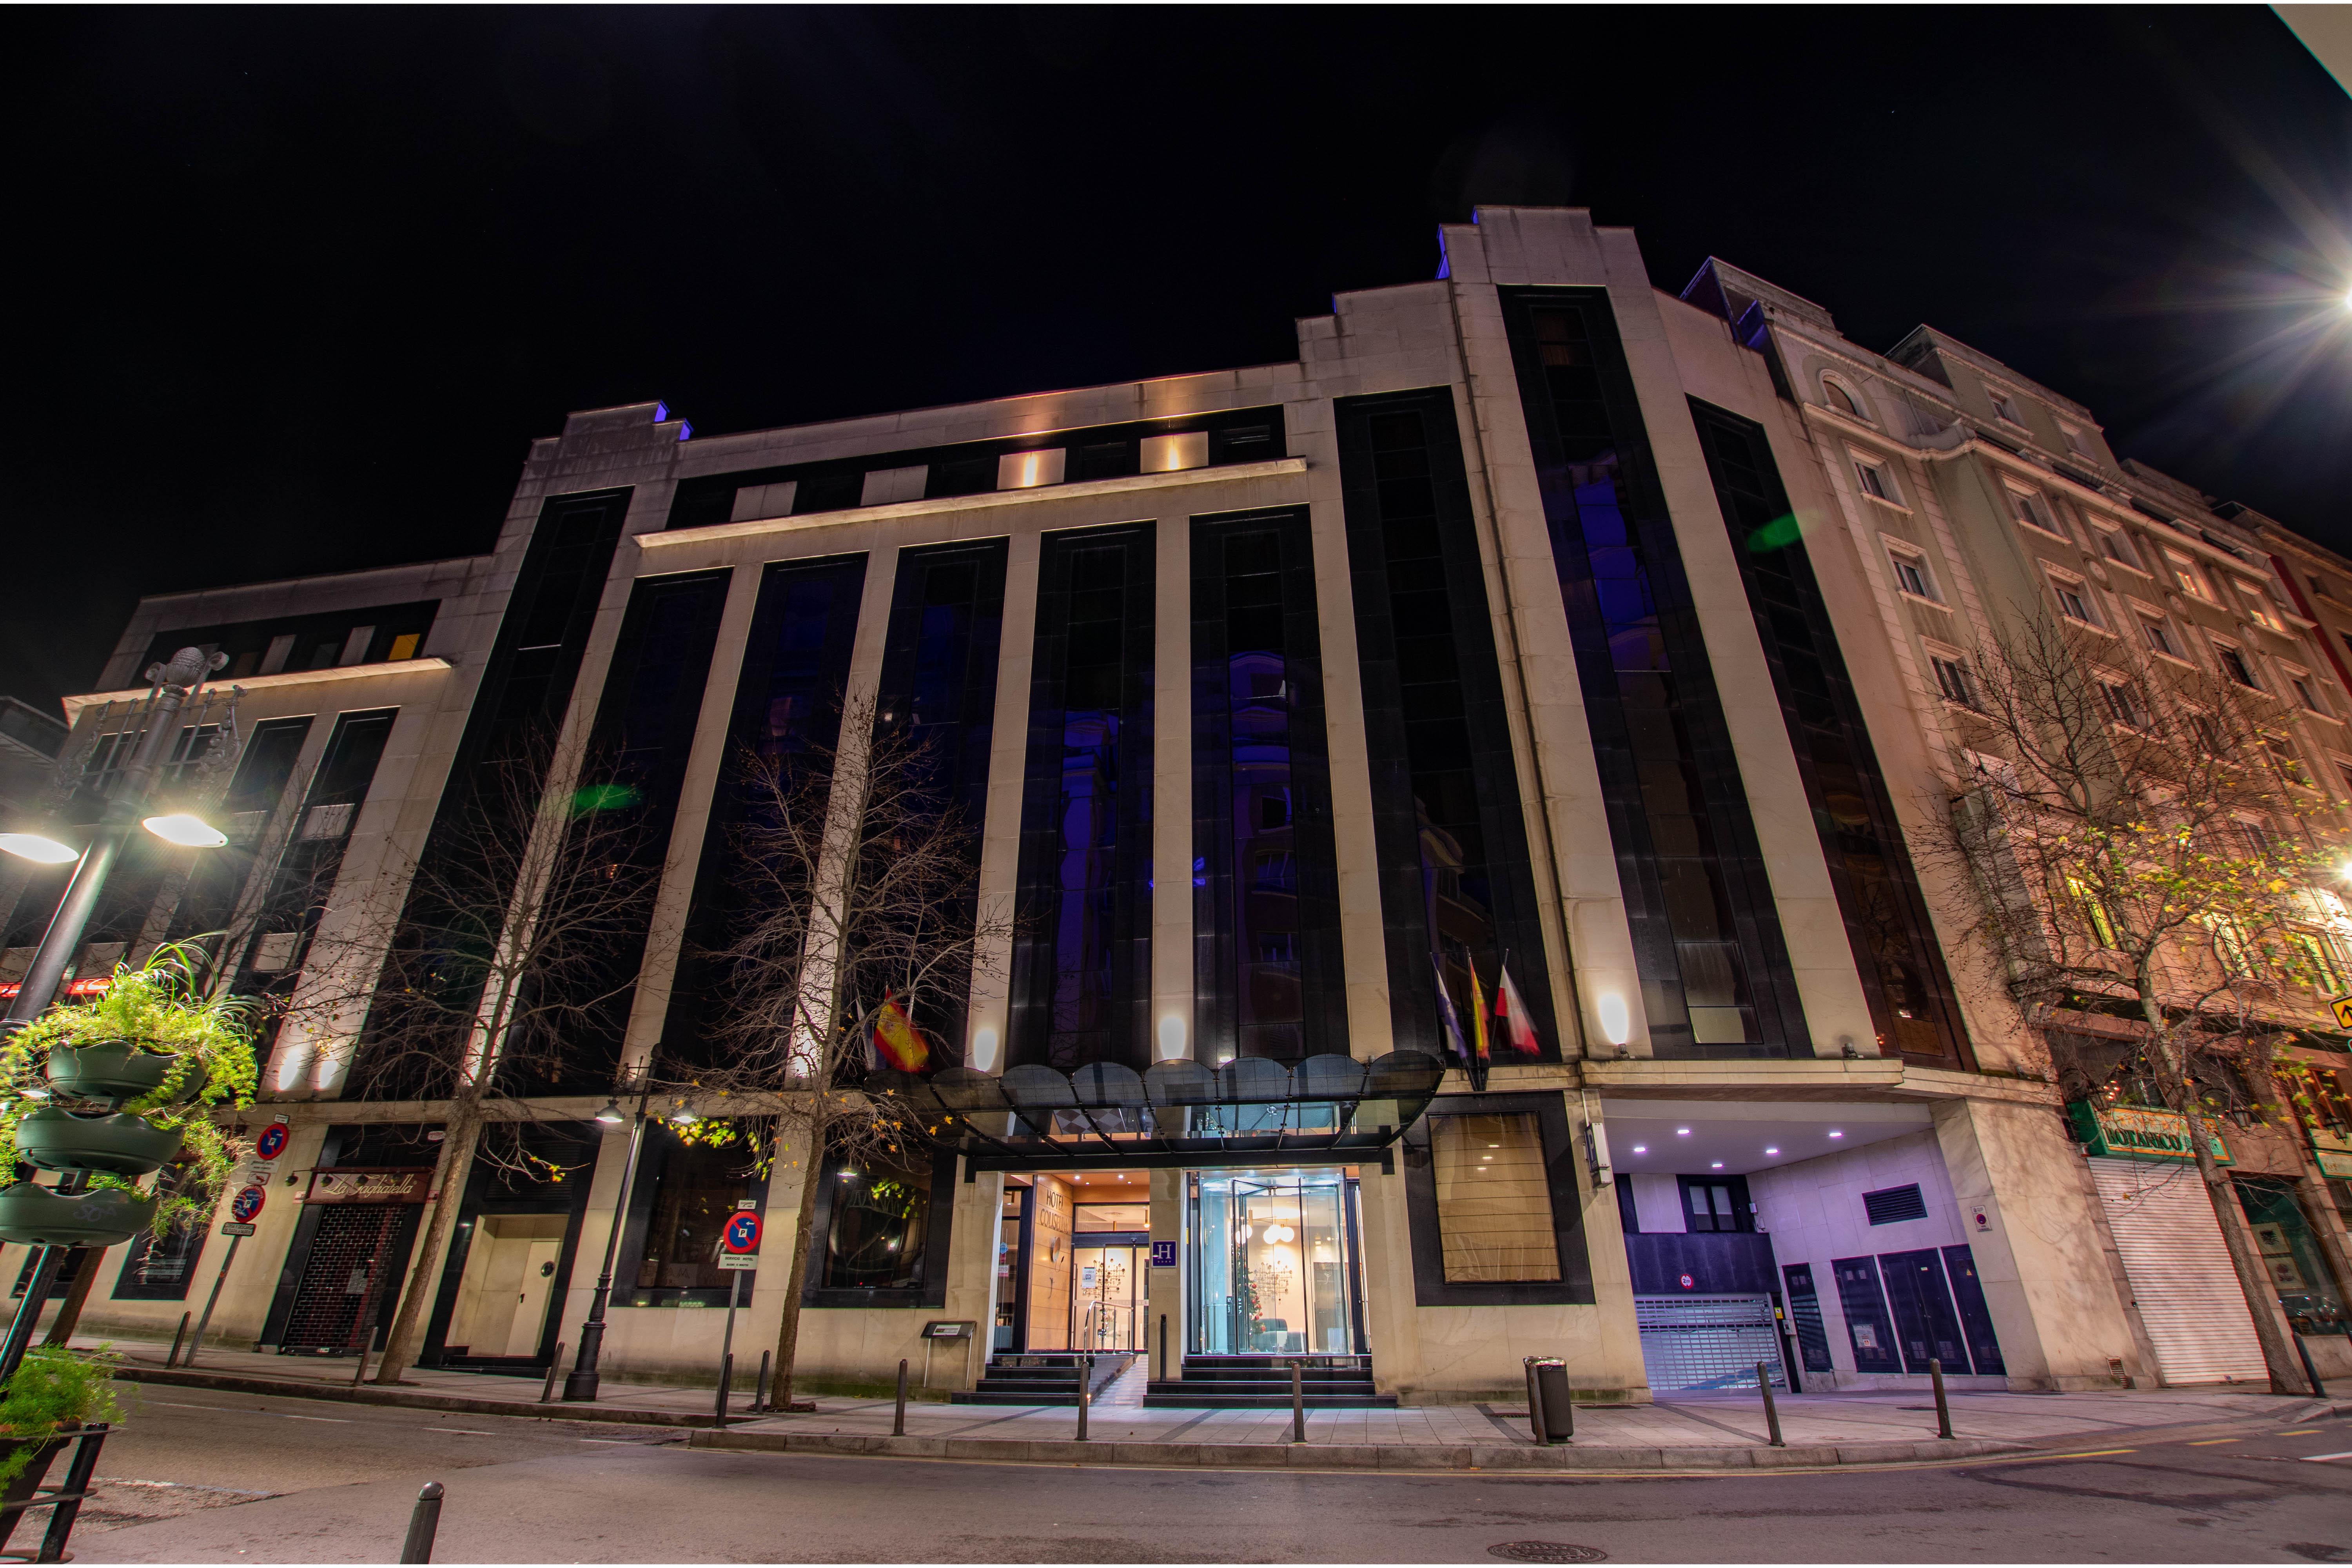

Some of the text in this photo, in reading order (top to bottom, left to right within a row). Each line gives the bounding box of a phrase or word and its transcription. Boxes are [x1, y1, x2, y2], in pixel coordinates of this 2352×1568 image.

[323, 1174, 350, 1194] La
[1047, 1189, 1063, 1212] HOTEL
[1040, 1209, 1068, 1234] COLISEUM
[1157, 1245, 1171, 1259] H
